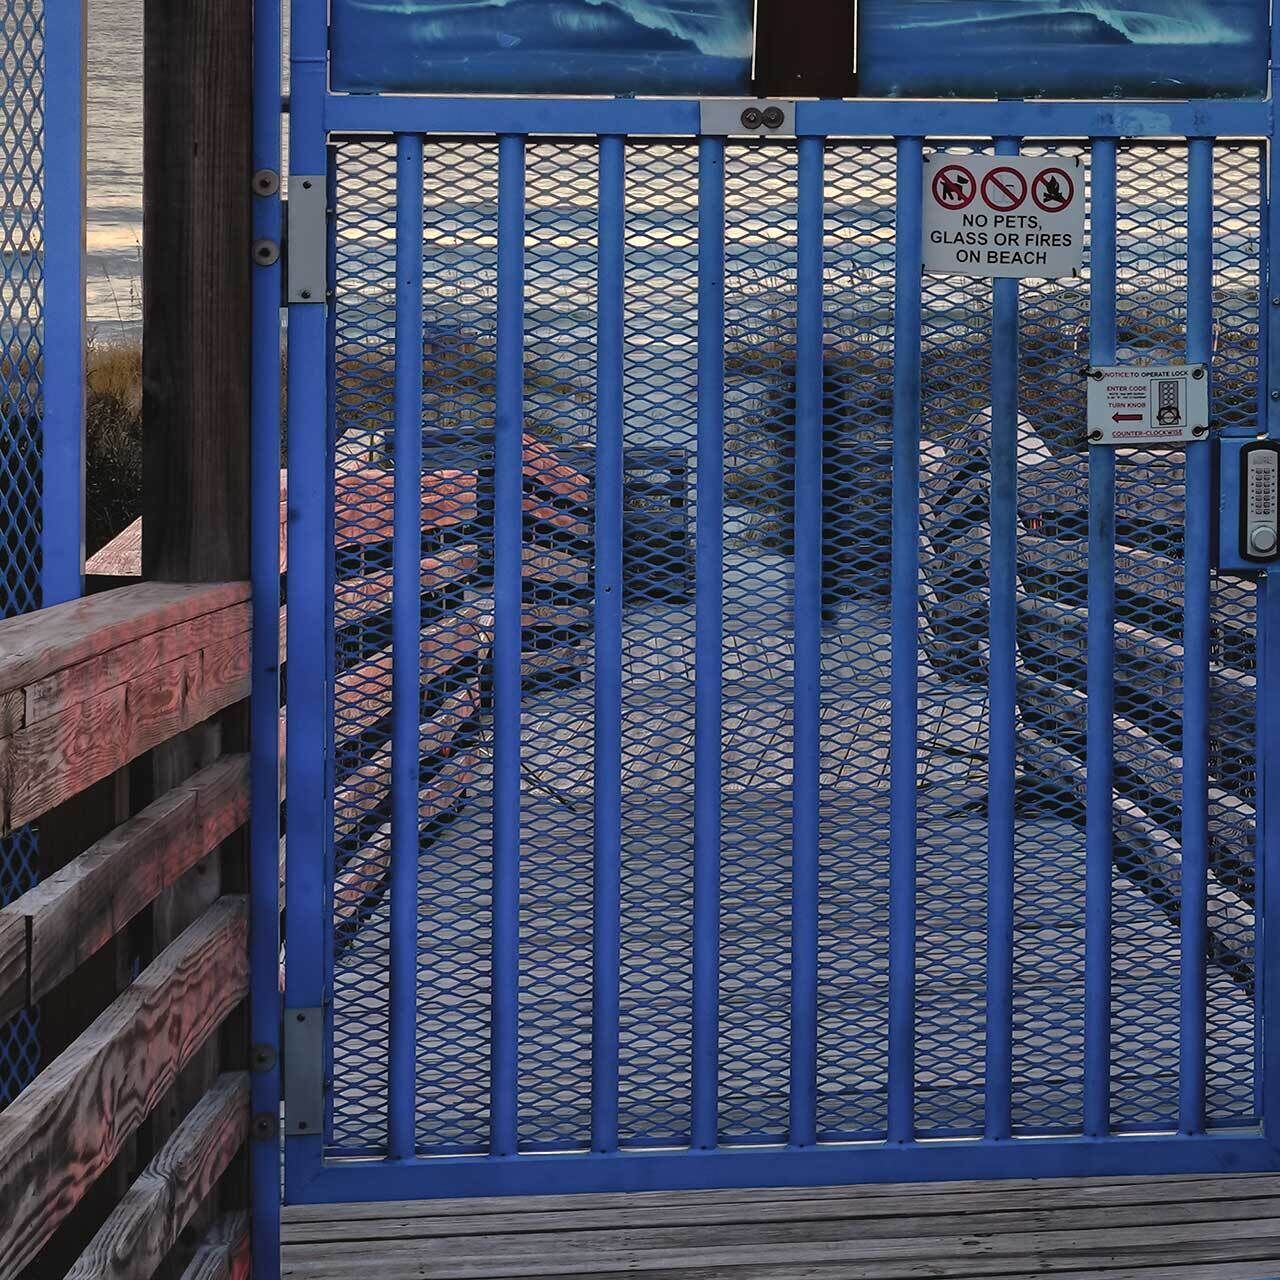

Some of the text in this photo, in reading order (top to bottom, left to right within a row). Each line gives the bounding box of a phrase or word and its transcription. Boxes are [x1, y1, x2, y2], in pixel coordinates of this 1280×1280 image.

[963, 214, 1043, 231] NO PETS,
[930, 231, 1072, 247] GLASS OR FIRES
[956, 250, 1047, 265] ON BEACH
